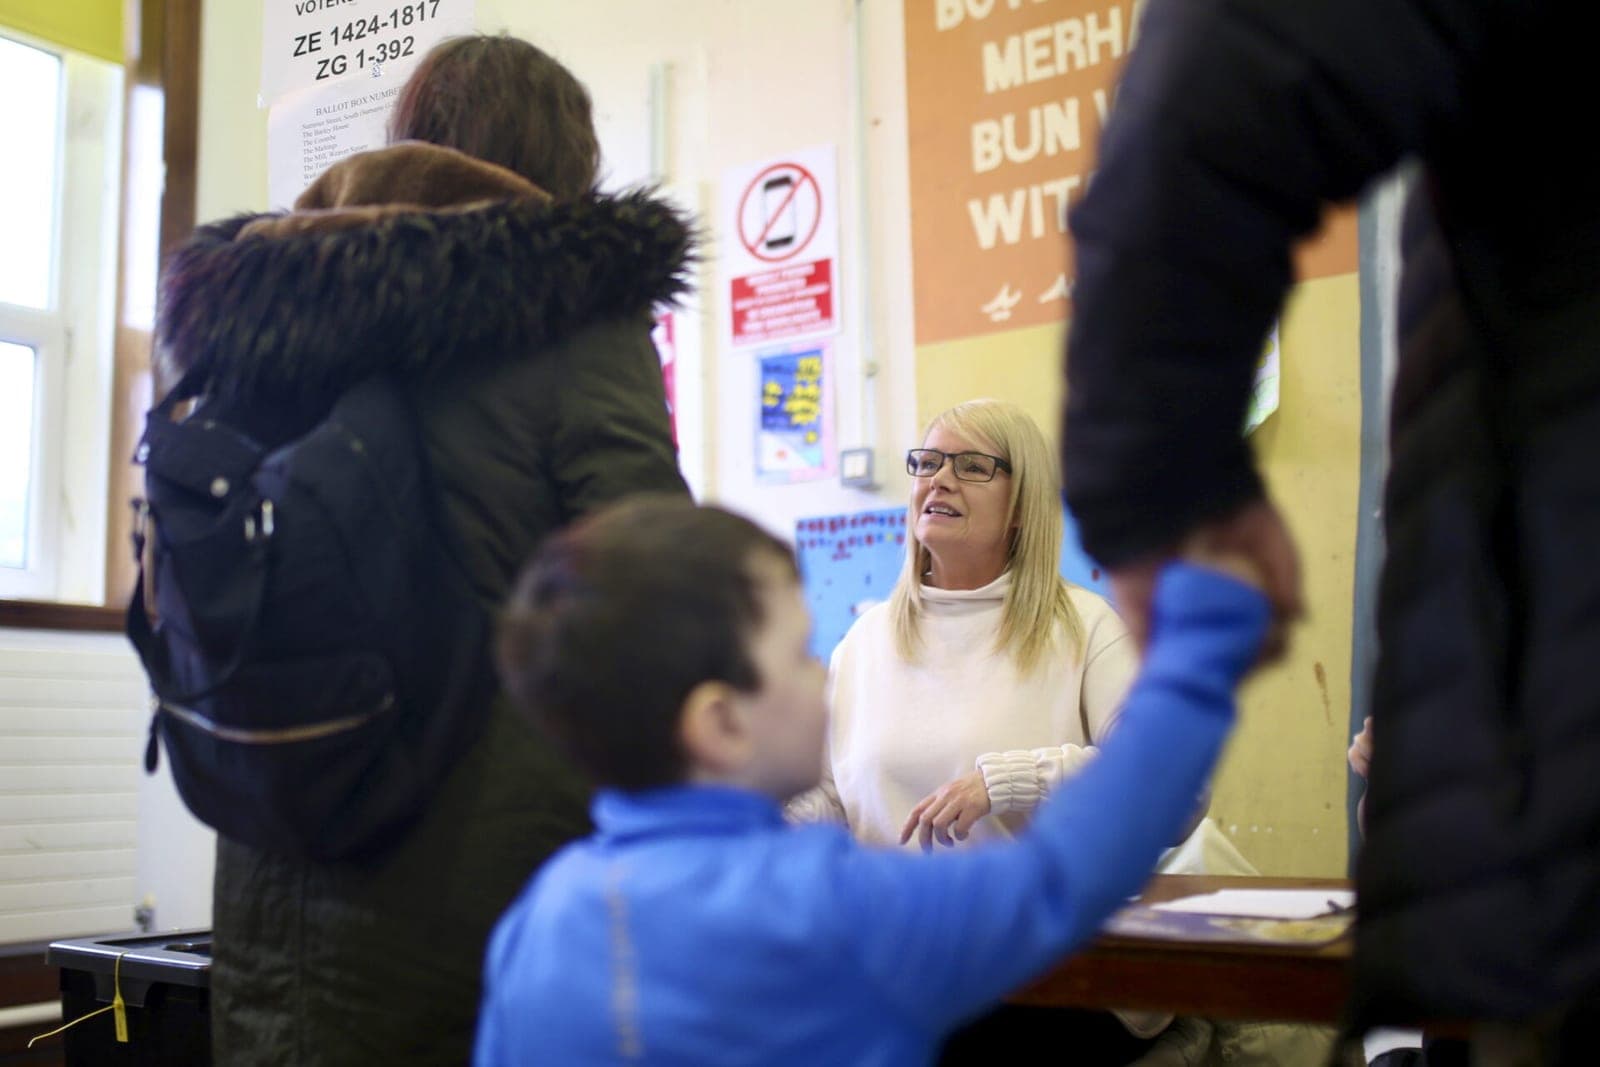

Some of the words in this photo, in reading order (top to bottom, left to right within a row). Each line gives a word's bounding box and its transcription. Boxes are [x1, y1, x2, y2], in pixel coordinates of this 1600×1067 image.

[293, 31, 321, 57] ZE
[330, 0, 440, 46] 1424-1817
[295, 0, 354, 16] VOTE
[315, 54, 347, 80] ZG
[356, 35, 415, 69] 1-392
[981, 0, 1140, 94] MERH
[315, 101, 349, 116] BALLOT
[350, 96, 367, 108] BOX
[971, 97, 1080, 174] BUN
[966, 172, 1086, 250] WIT
